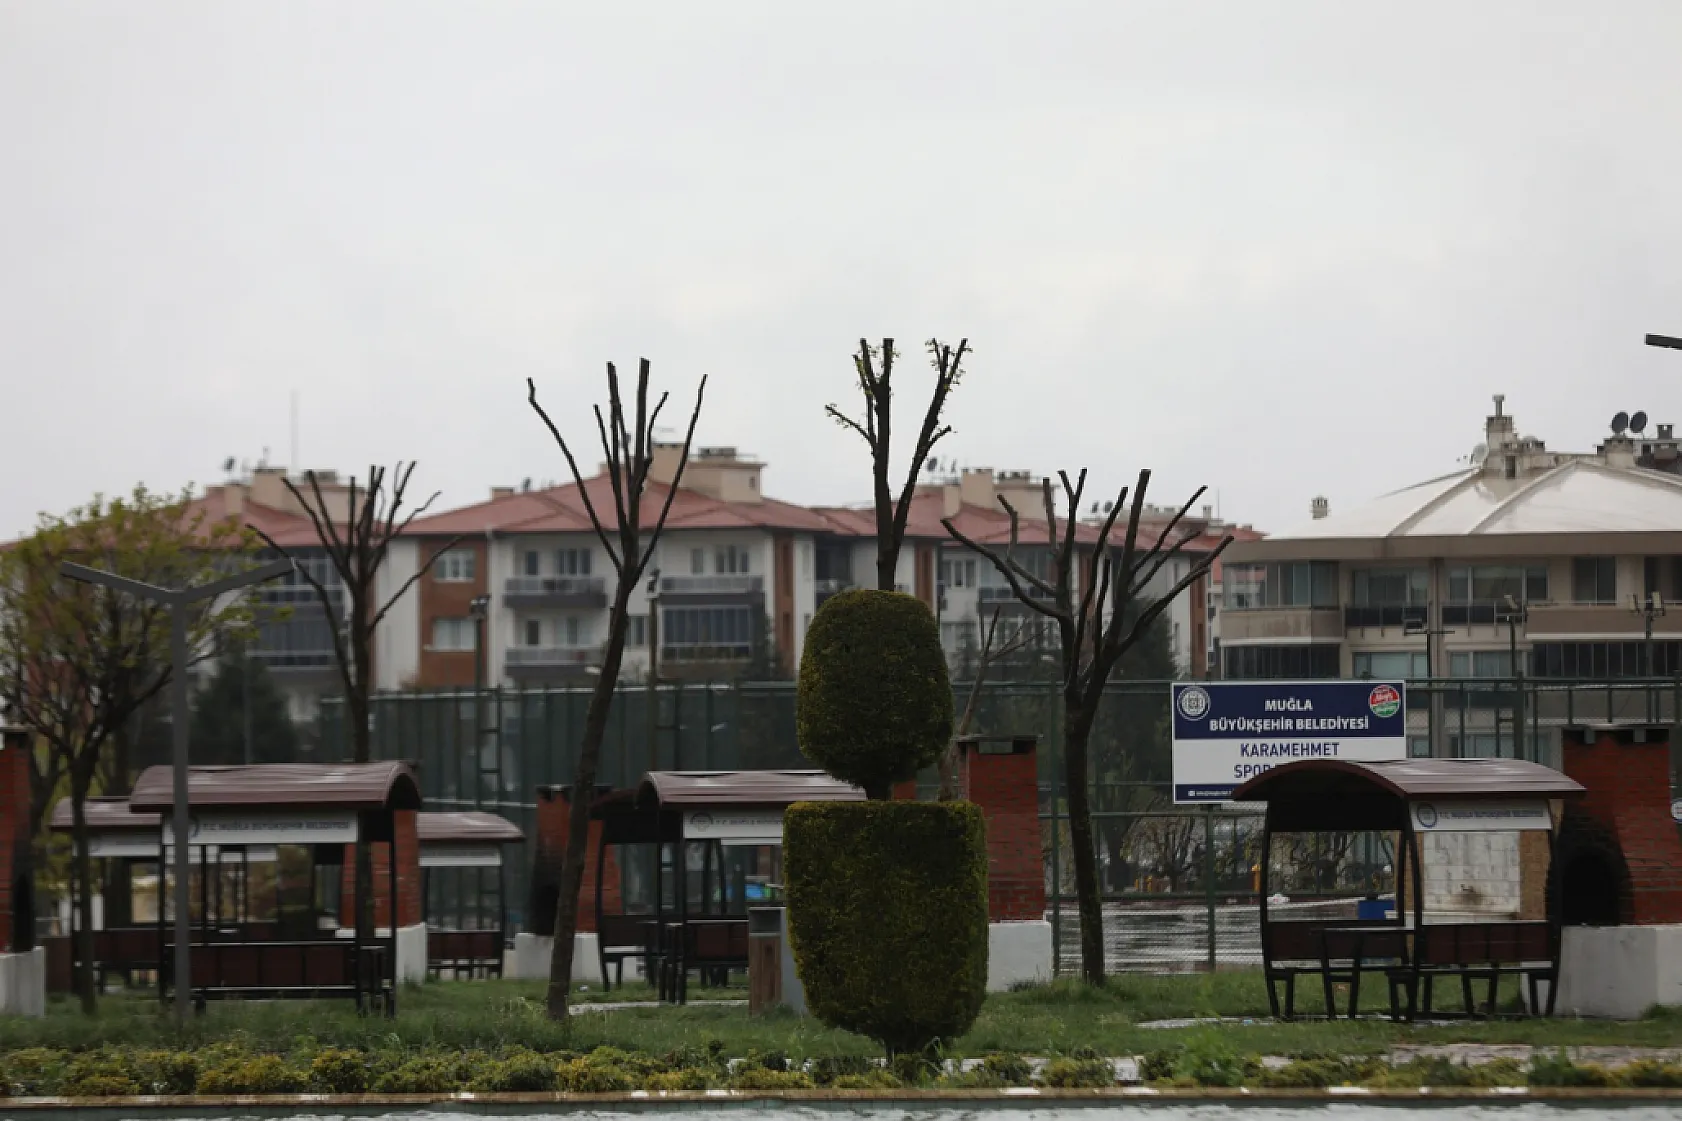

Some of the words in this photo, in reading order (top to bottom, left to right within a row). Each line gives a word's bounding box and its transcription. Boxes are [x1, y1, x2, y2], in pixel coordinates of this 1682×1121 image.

[1265, 697, 1313, 712] MUĞLA
[1209, 716, 1294, 733] BÜYÜKŞEHİR
[1296, 715, 1369, 730] BELEDİYESİ
[1240, 742, 1340, 757] KARAMEHMET
